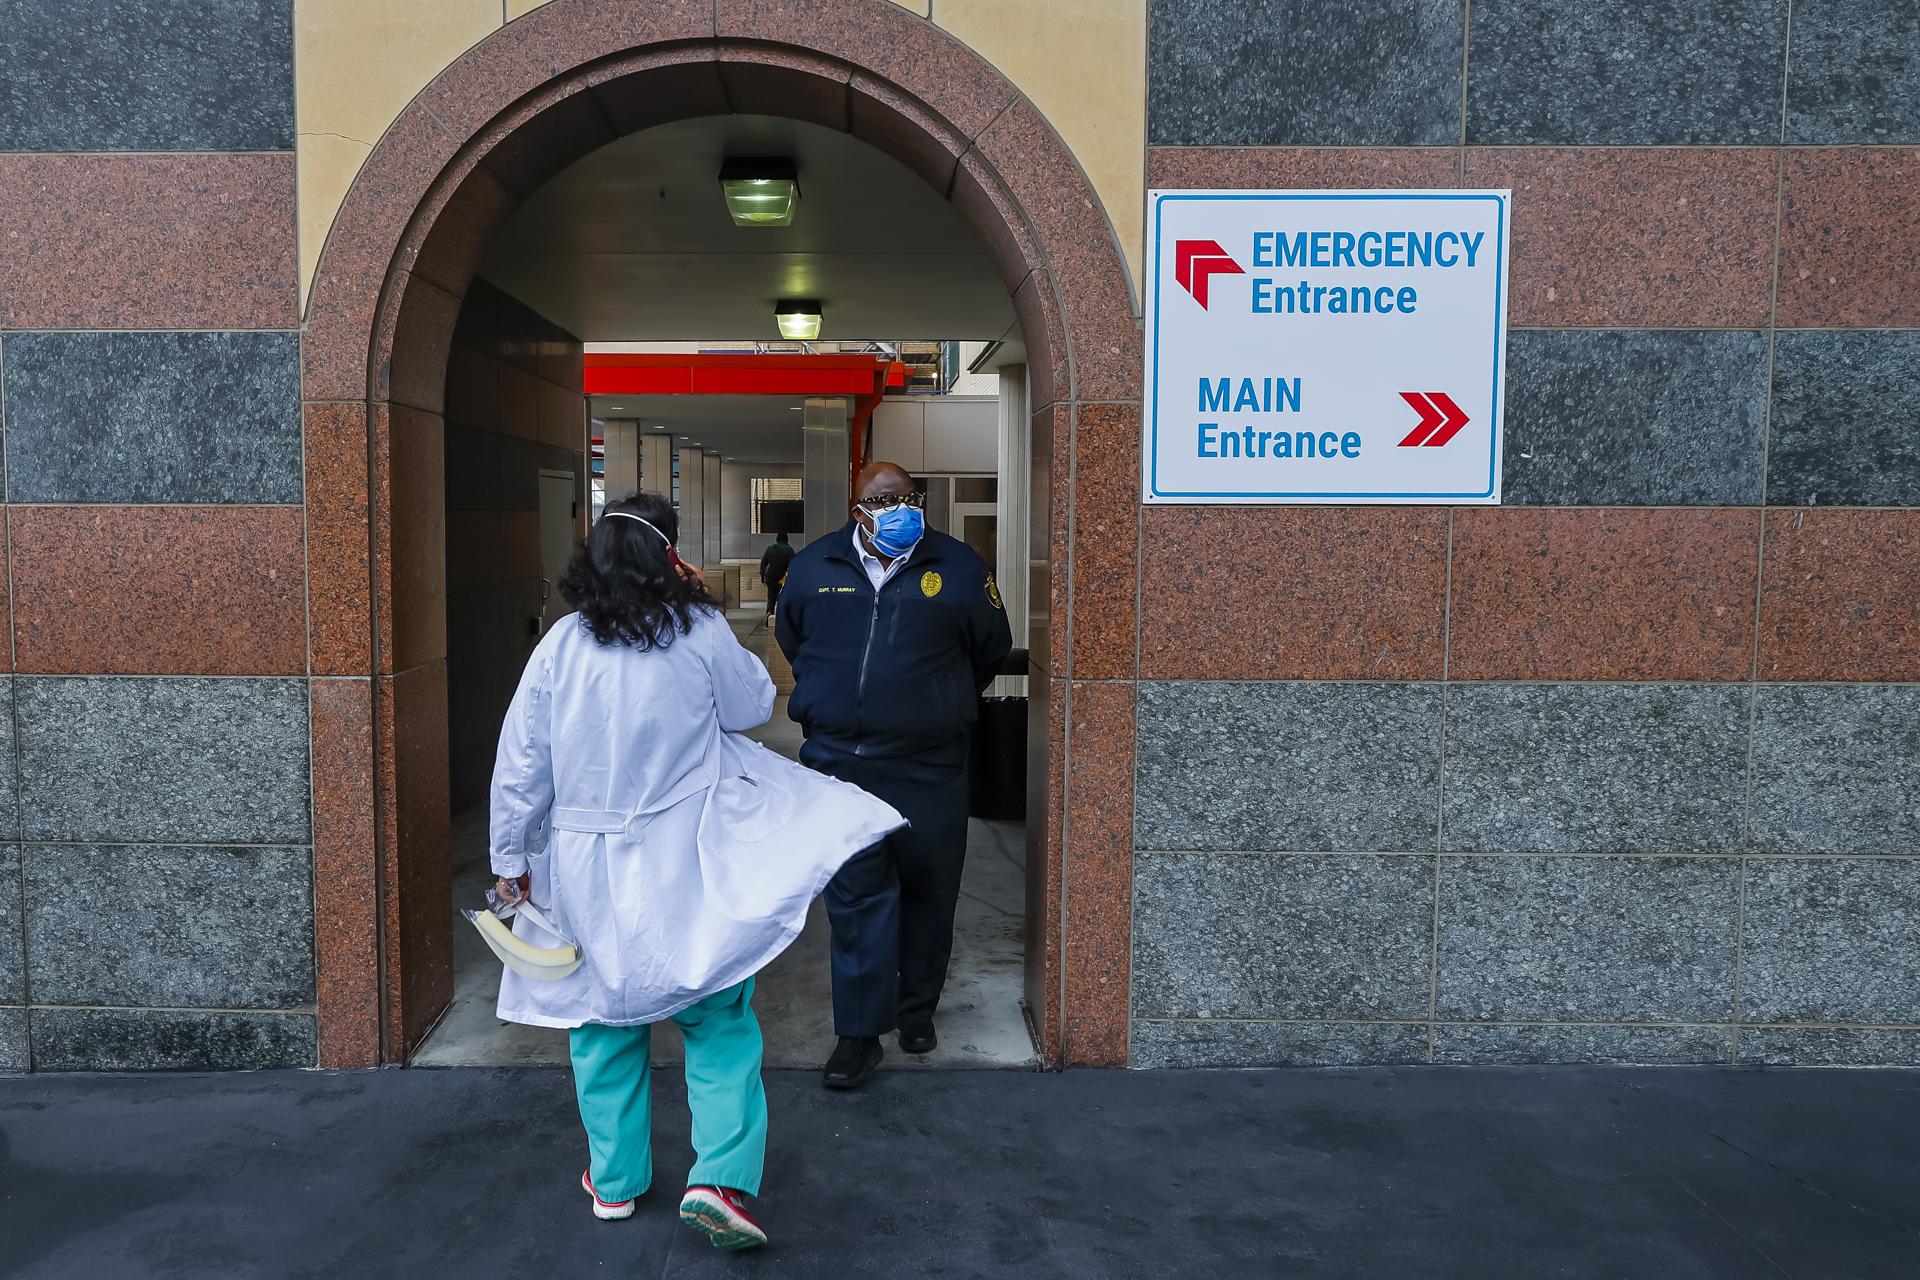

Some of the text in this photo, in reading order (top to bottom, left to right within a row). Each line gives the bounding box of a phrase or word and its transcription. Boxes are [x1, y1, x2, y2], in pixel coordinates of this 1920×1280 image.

[1253, 231, 1485, 268] EMERGENCY
[1251, 278, 1418, 314] Entrance
[1198, 377, 1302, 413] MAIN
[1197, 423, 1362, 458] Entrance
